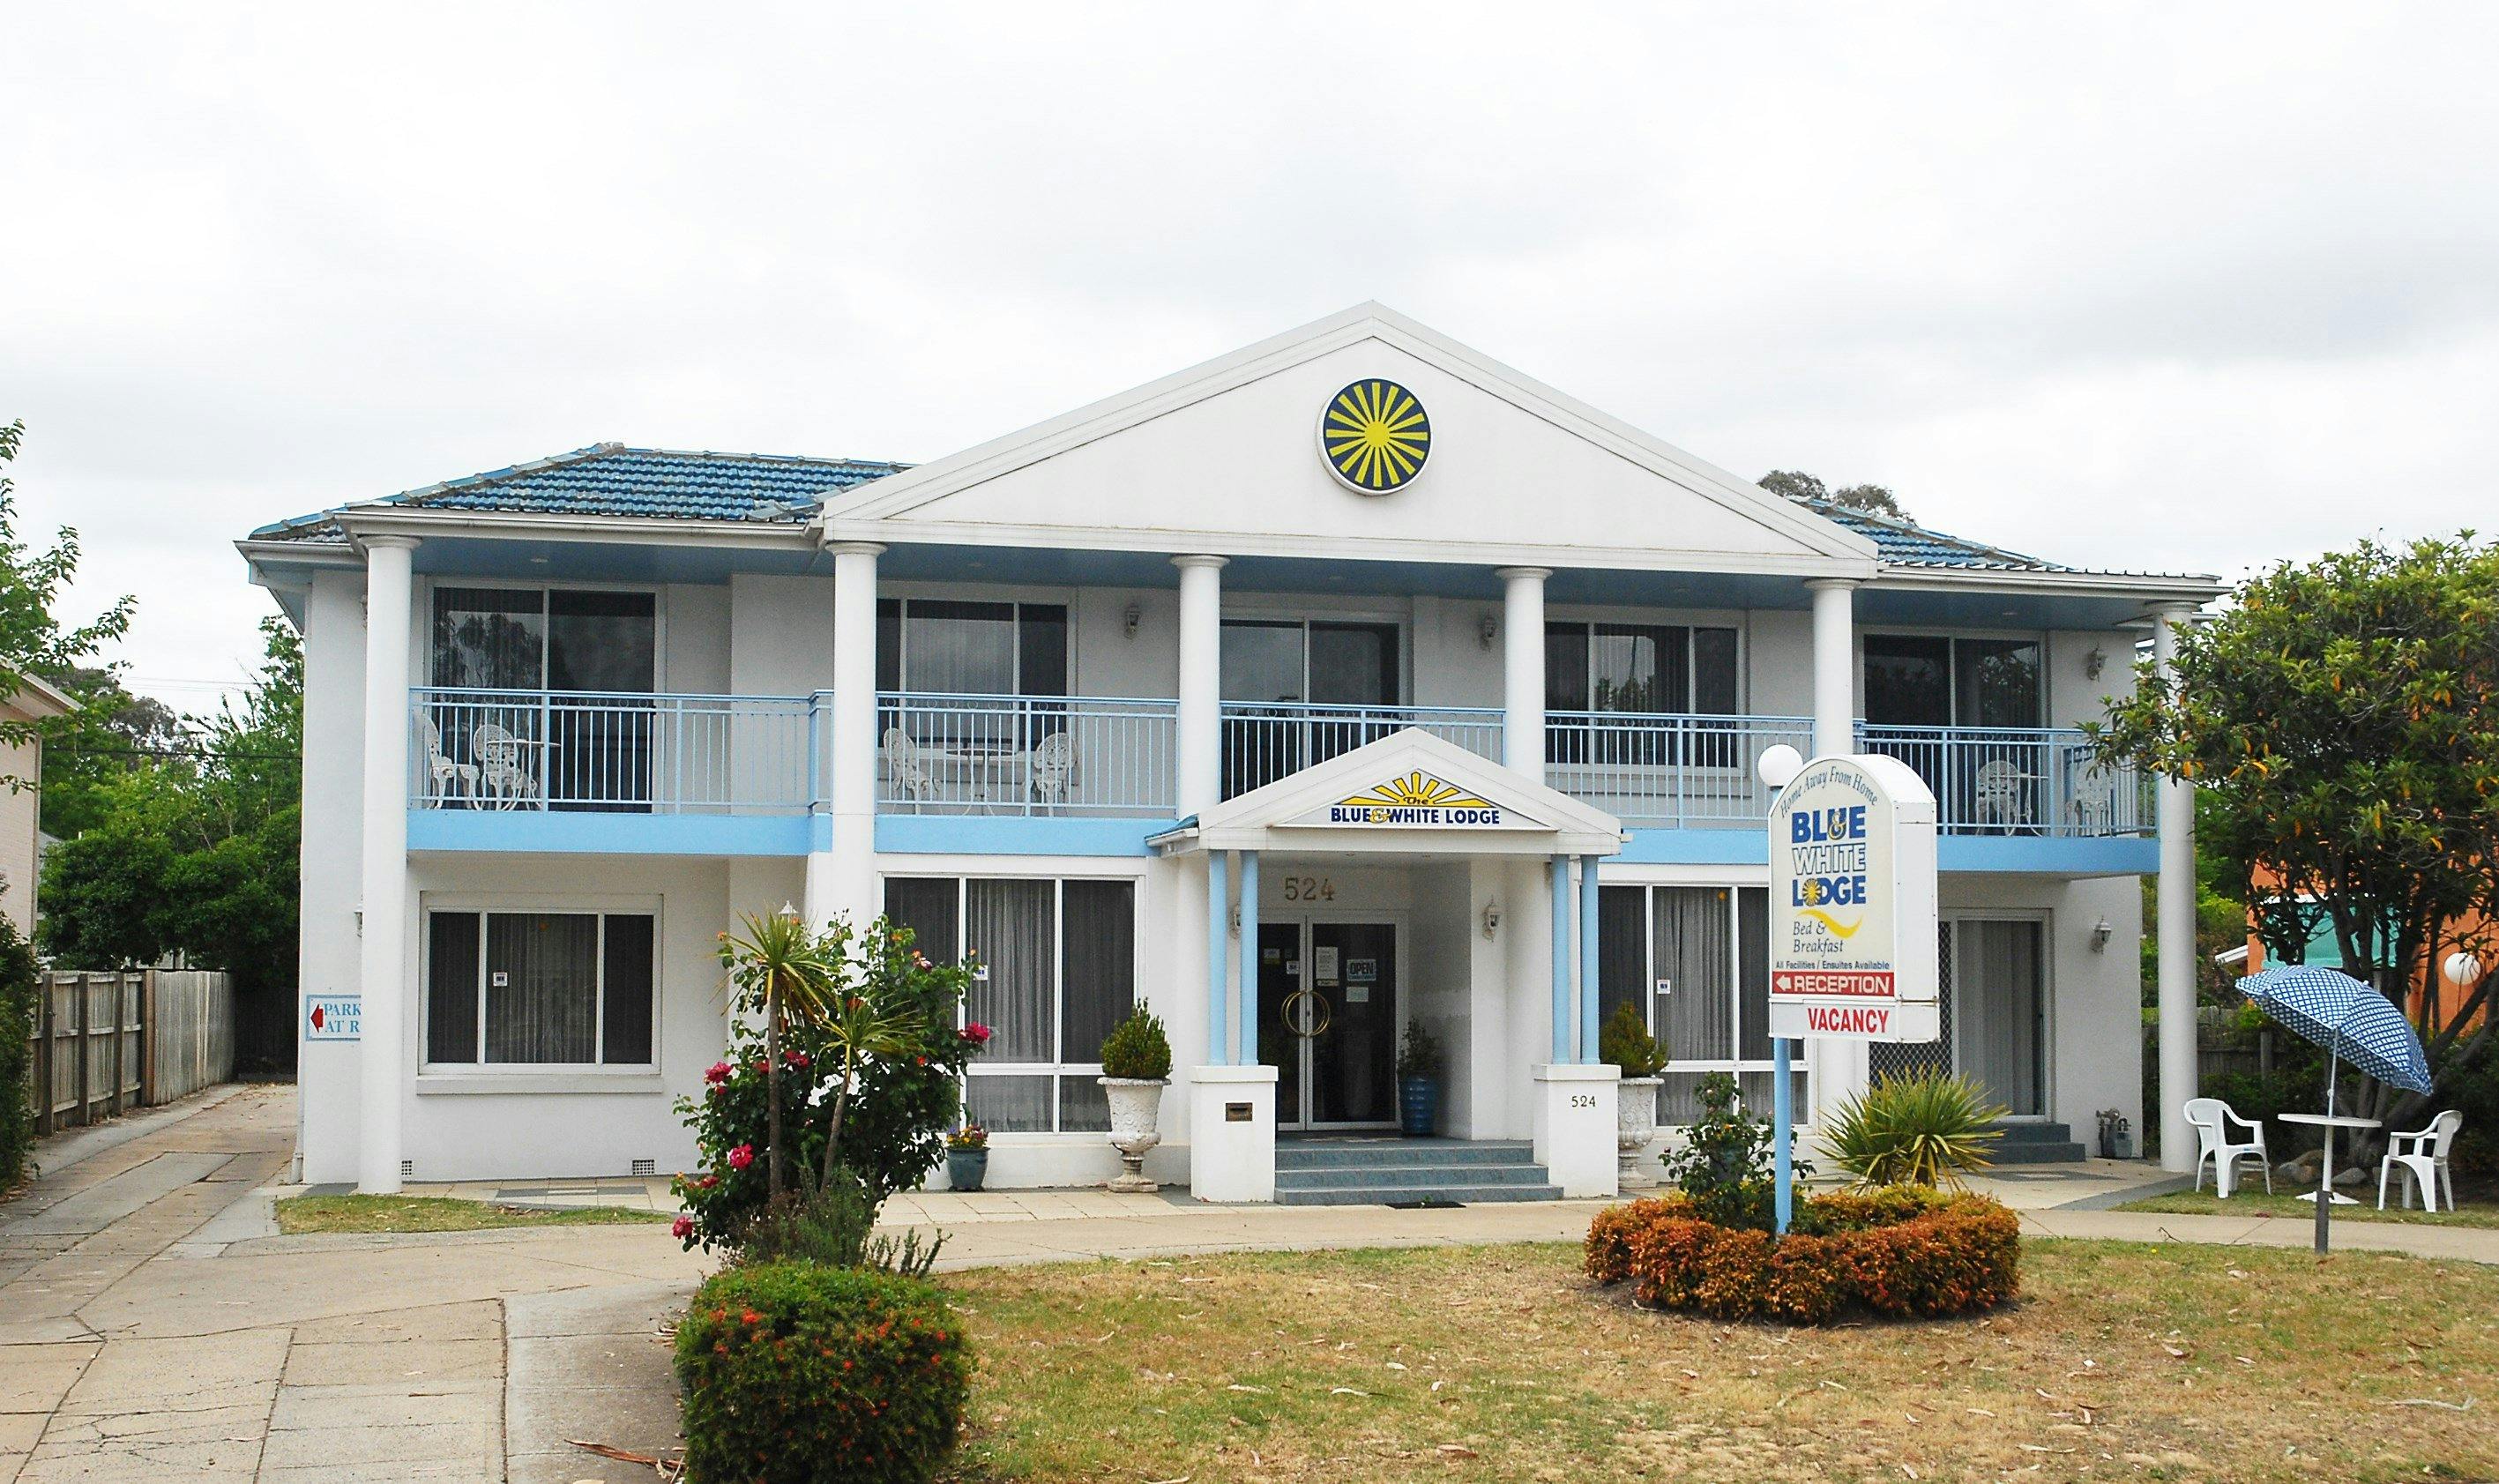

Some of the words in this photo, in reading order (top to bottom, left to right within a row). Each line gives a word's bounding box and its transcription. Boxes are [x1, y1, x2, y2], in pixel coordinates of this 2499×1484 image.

[1402, 796, 1429, 805] The
[1780, 785, 1802, 818] Home
[1803, 770, 1827, 791] Away
[1829, 765, 1851, 786] From
[1852, 773, 1878, 806] Home
[1331, 808, 1371, 823] BLUE
[1388, 809, 1439, 824] WHITE
[1445, 809, 1500, 824] LODGE
[1792, 805, 1866, 844] BLUE
[1792, 842, 1866, 876] WHITE
[1284, 877, 1335, 901] 524
[1793, 921, 1813, 936] Bed
[1816, 921, 1827, 936] &
[1793, 938, 1844, 958] Breakfast
[1349, 962, 1375, 975] OPEN
[1786, 960, 1816, 970] Facilities
[1822, 960, 1853, 970] Ensuites
[1854, 959, 1891, 970] Available
[1794, 974, 1891, 995] RECEPTION
[326, 1020, 344, 1033] AT
[1807, 1008, 1890, 1033] VACANCY
[1571, 1095, 1596, 1107] 524
